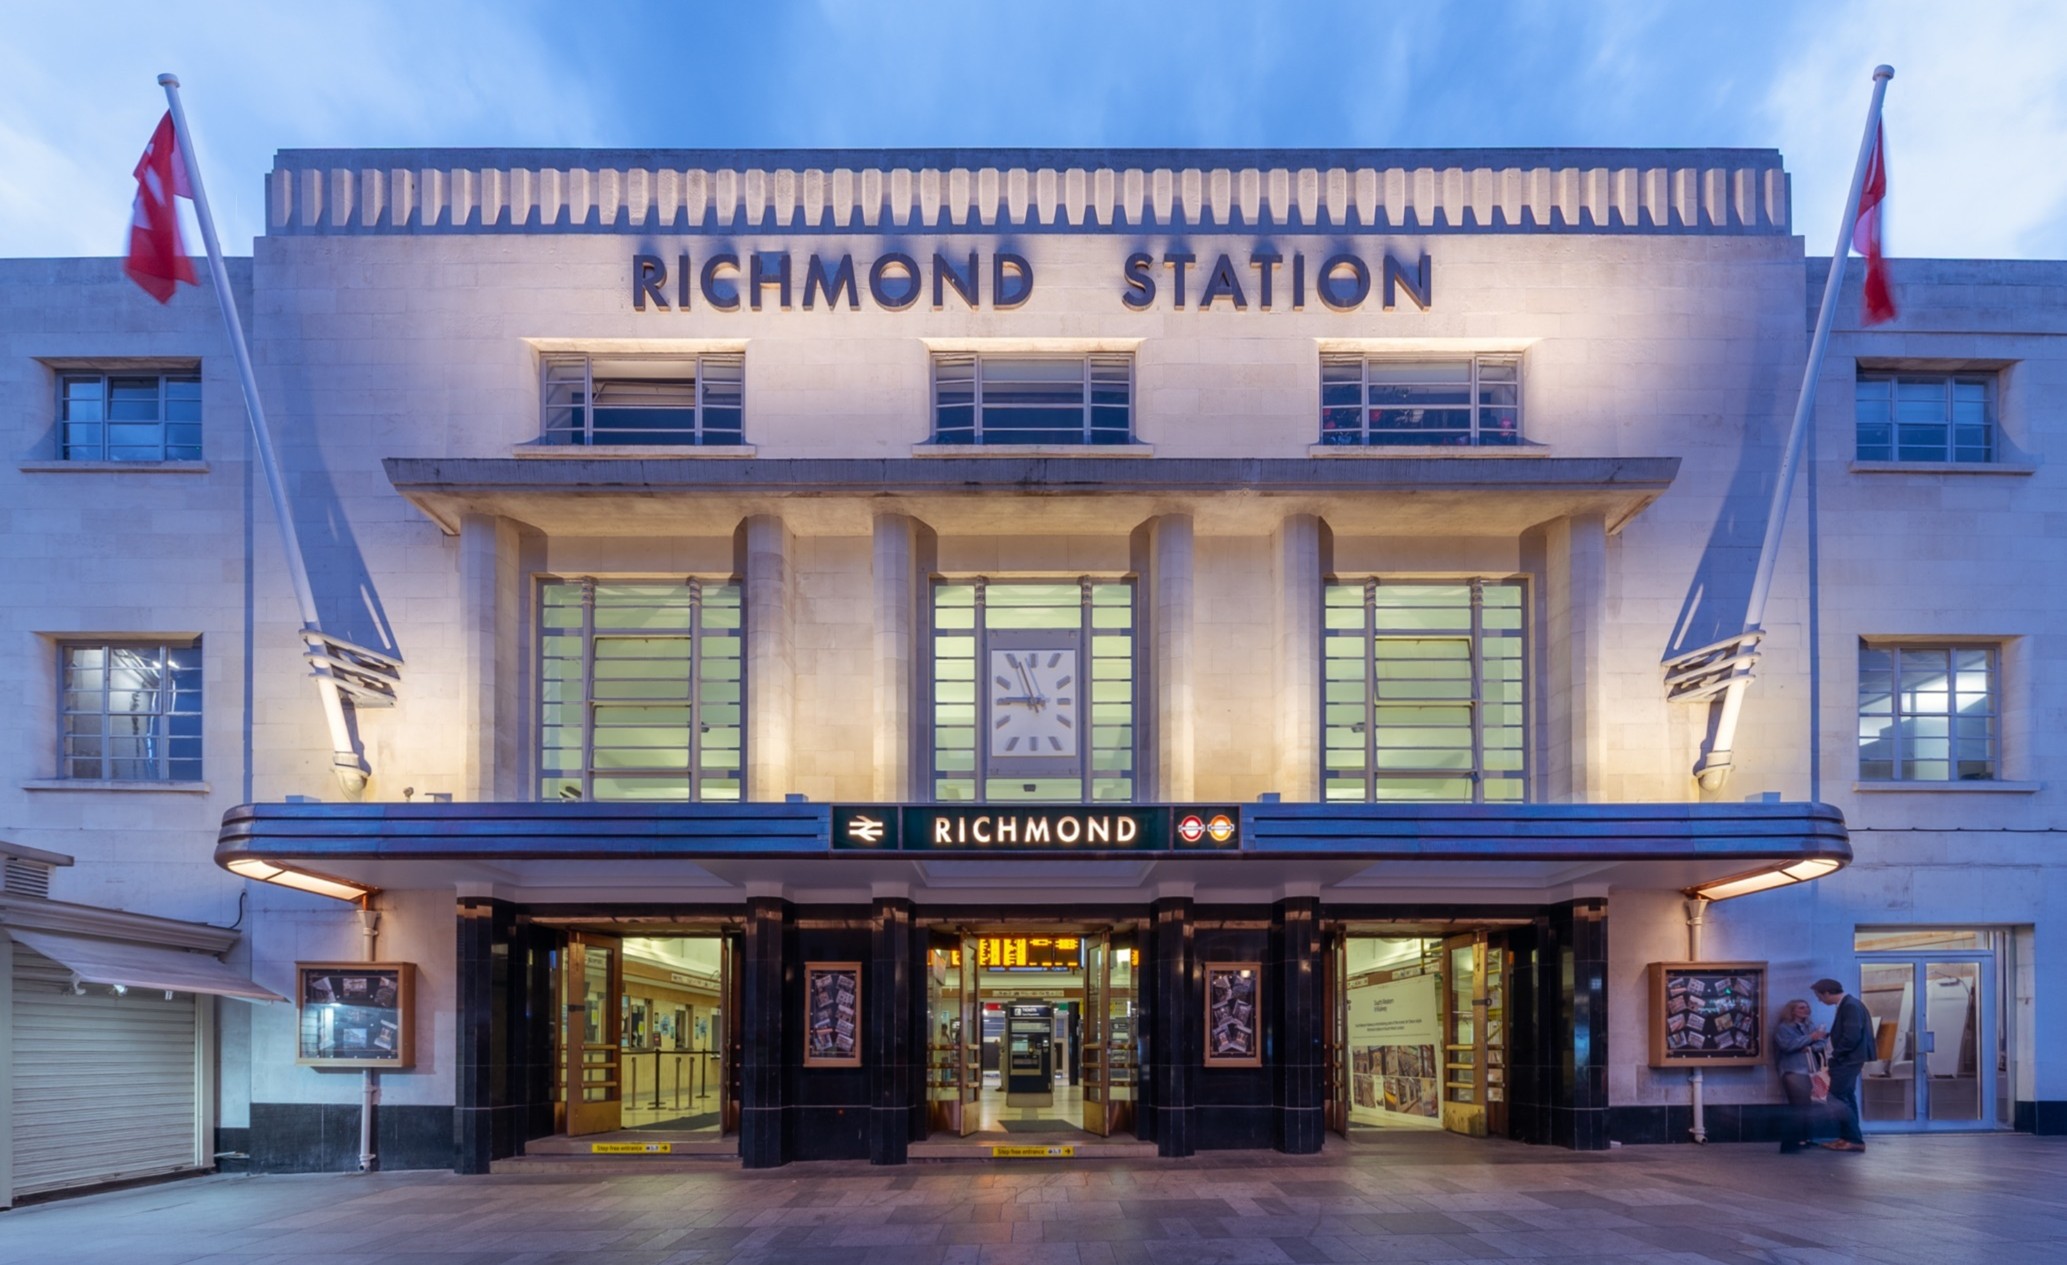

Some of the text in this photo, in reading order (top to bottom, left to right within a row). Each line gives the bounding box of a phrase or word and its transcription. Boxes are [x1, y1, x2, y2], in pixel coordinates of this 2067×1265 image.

[633, 251, 1432, 312] RICHMOND STATION
[935, 815, 1137, 843] RICHMOND
